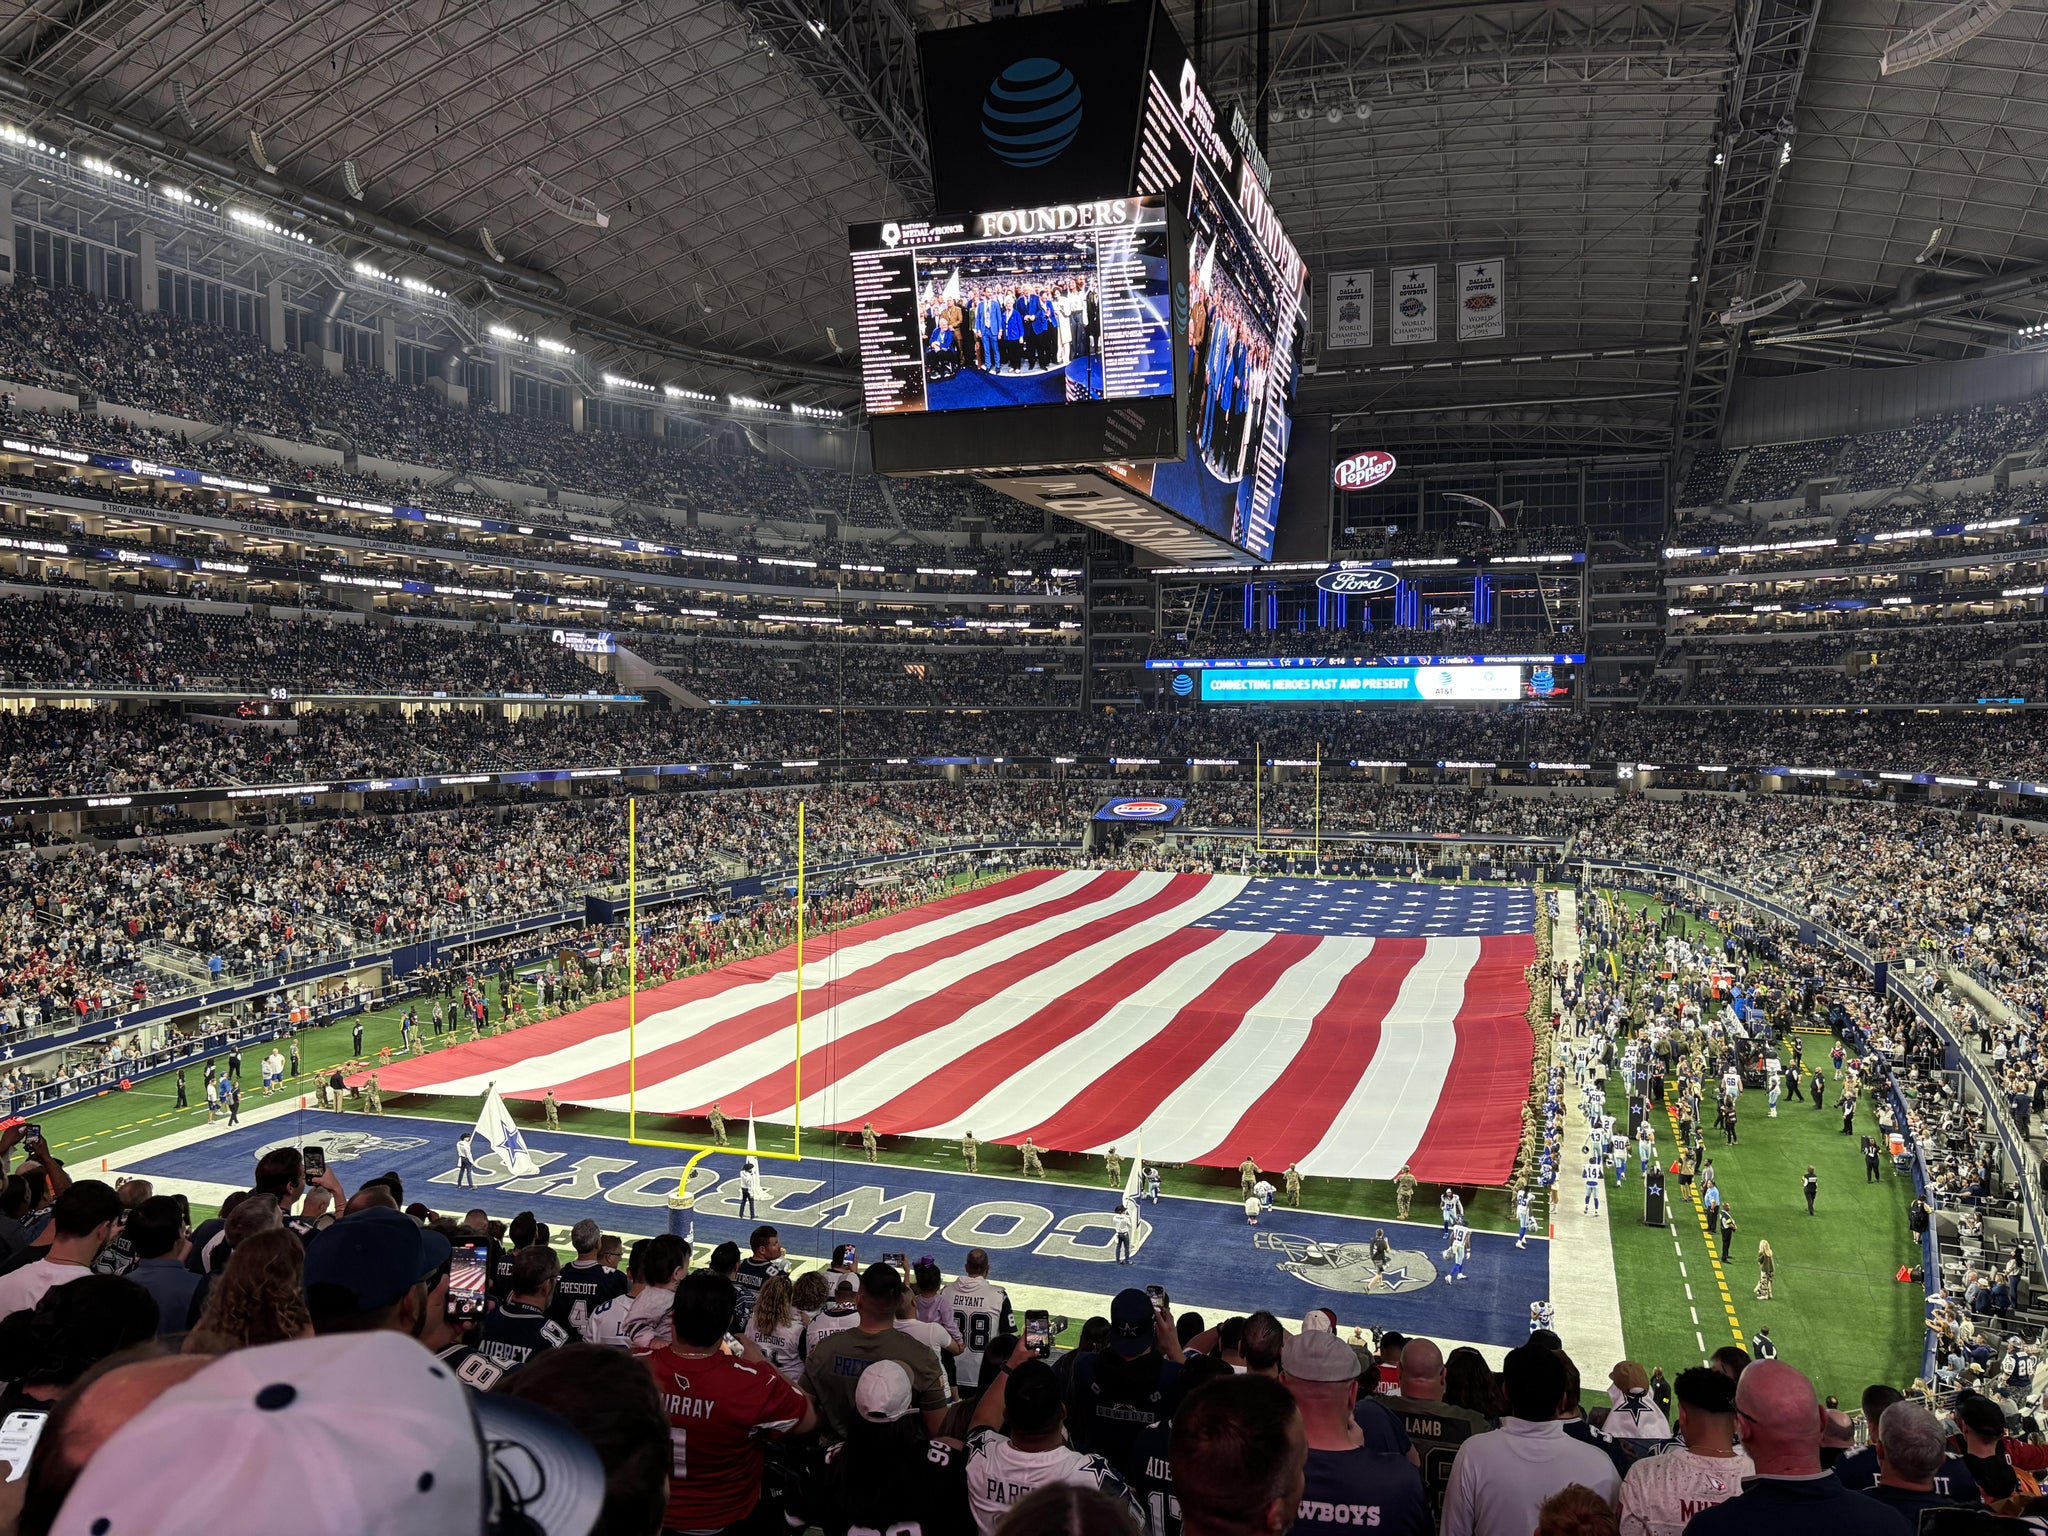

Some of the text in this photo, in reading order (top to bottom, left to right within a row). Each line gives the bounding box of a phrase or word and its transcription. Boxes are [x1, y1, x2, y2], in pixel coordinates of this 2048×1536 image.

[981, 199, 1128, 238] FOUNDERS
[901, 222, 930, 230] NATIONAL
[1239, 163, 1300, 292] FOUNDERS
[902, 228, 930, 239] MEDAL
[1402, 282, 1425, 290] DALLAS
[1469, 277, 1493, 285] DALLAS
[1339, 288, 1362, 296] DALLAS
[1400, 288, 1428, 296] COWBOYS
[1466, 283, 1495, 291] COWBOYS
[1337, 293, 1364, 301] COWBOYS
[1402, 319, 1426, 327] WORLD
[1468, 315, 1493, 323] WORLD
[1394, 326, 1433, 334] CHAMPIONS
[1461, 321, 1501, 330] CHAMPIONS
[1331, 331, 1369, 339] CHAMPIONS
[1355, 455, 1378, 471] Dr
[1337, 460, 1392, 486] Pepper
[108, 505, 127, 513] TROY
[128, 507, 155, 517] AIKMAN
[250, 525, 274, 534] EMMITT
[275, 528, 295, 537] SMITH
[388, 543, 406, 551] ALLEN
[2020, 550, 2042, 558] HARRIS
[1853, 565, 1882, 573] RAYFIELD
[1883, 563, 1908, 571] WRIGHT
[1332, 572, 1382, 591] Ford
[1328, 657, 1345, 665] 5:14
[1210, 678, 1410, 690] CONNECTING HEROES PAST AND PRESENT
[1445, 761, 1496, 769] Blockchain.com
[1537, 762, 1590, 770] Blockchain.com
[1588, 1168, 1597, 1179] 14
[428, 1149, 1153, 1263] COWBOYS
[497, 1262, 513, 1276] PRE
[559, 1282, 598, 1296] PRESCOTT
[953, 1295, 985, 1308] BRYANT
[568, 1300, 589, 1331] 4
[754, 1332, 786, 1348] PARSONS
[478, 1339, 533, 1364] AUBREY
[1096, 1406, 1155, 1423] COWBOYS
[1405, 1417, 1442, 1437] LAMB
[1298, 1499, 1381, 1527] WBOYS
